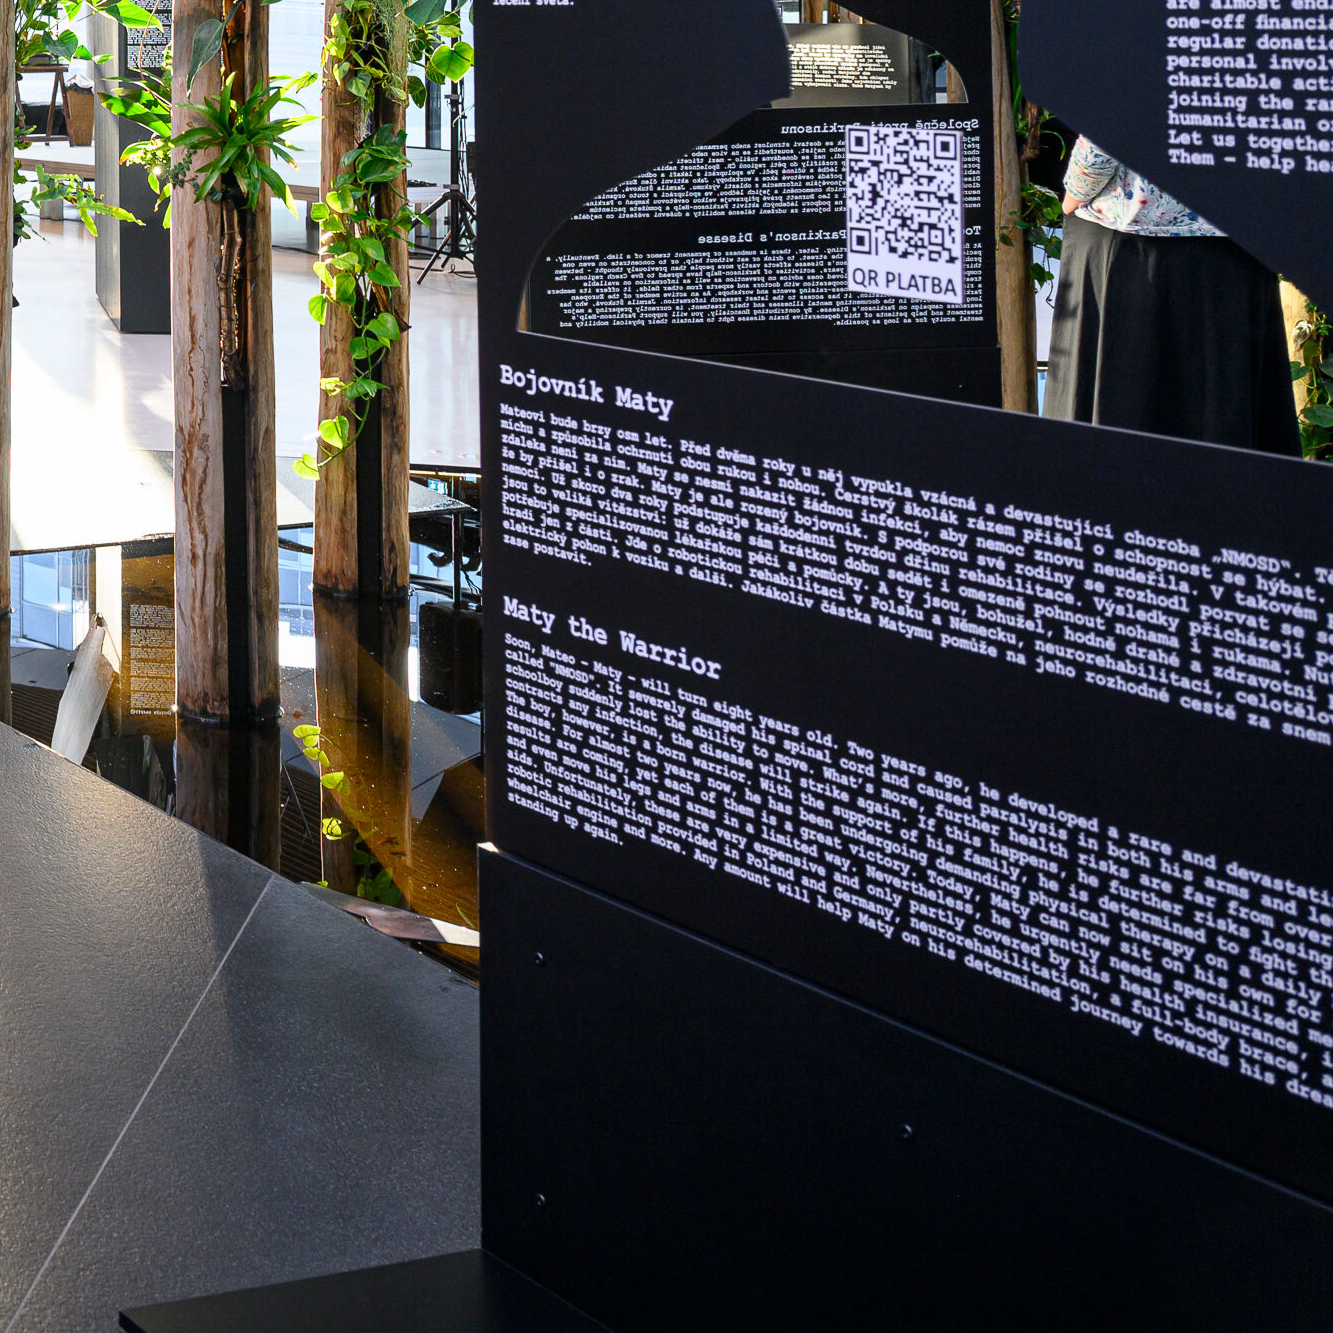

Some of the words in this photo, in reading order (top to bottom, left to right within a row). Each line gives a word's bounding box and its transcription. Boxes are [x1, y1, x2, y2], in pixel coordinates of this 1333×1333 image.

[1167, 108, 1306, 131] humanitarian
[851, 267, 879, 290] QR
[885, 271, 958, 297] PLATBA
[499, 364, 605, 405] Bojovník
[615, 385, 674, 422] Maty
[499, 401, 545, 423] Mateovi
[549, 412, 578, 429] bude
[582, 419, 611, 440] brzy
[616, 428, 639, 442] osm
[644, 431, 672, 449] let.
[762, 454, 795, 477] roky
[801, 465, 811, 477] u
[850, 472, 913, 502] vypukla
[984, 502, 995, 515] a
[1124, 527, 1200, 558] choroba
[503, 533, 529, 549] zase
[532, 539, 591, 569] postavit.
[503, 595, 556, 634] Maty
[568, 615, 608, 645] the
[619, 629, 722, 681] Warrior
[505, 688, 525, 707] The
[529, 696, 555, 720] boy,
[561, 708, 614, 739] however,
[622, 728, 637, 745] is
[642, 738, 651, 750] a
[655, 740, 686, 763] born
[691, 752, 751, 785] warrior.
[759, 776, 793, 800] With
[799, 789, 825, 811] the
[832, 801, 892, 838] support
[899, 824, 918, 843] of
[925, 833, 954, 856] his
[962, 845, 1027, 885] family,
[1038, 871, 1059, 892] he
[1068, 882, 1088, 903] is
[1098, 892, 1206, 944] determined
[1216, 934, 1239, 955] to
[1249, 944, 1297, 979] fight
[507, 789, 559, 823] standing
[583, 818, 623, 849] again.
